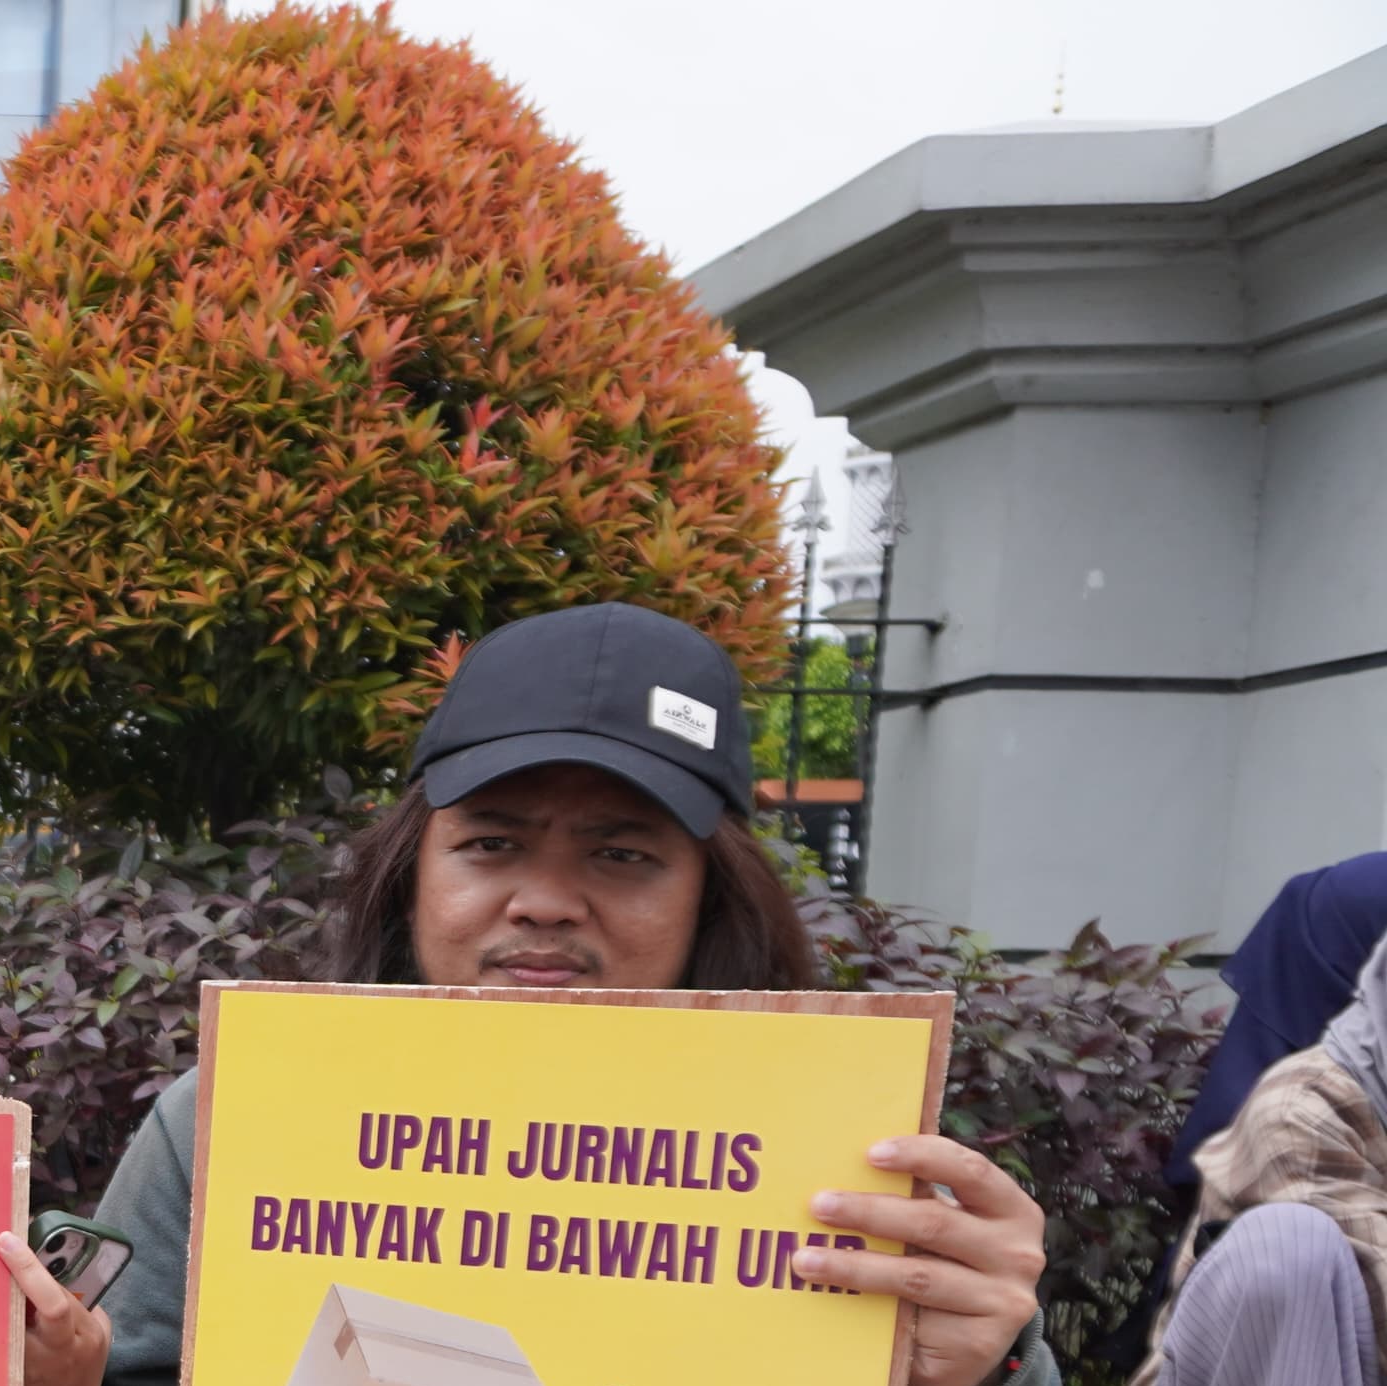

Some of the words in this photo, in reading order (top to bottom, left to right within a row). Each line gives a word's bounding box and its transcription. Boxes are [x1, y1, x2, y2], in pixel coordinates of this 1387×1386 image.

[359, 1112, 491, 1176] UPAH
[507, 1121, 762, 1192] JURNALIS
[250, 1196, 444, 1263] BANYAK
[460, 1210, 511, 1269] DI
[526, 1215, 719, 1286] BAWAH
